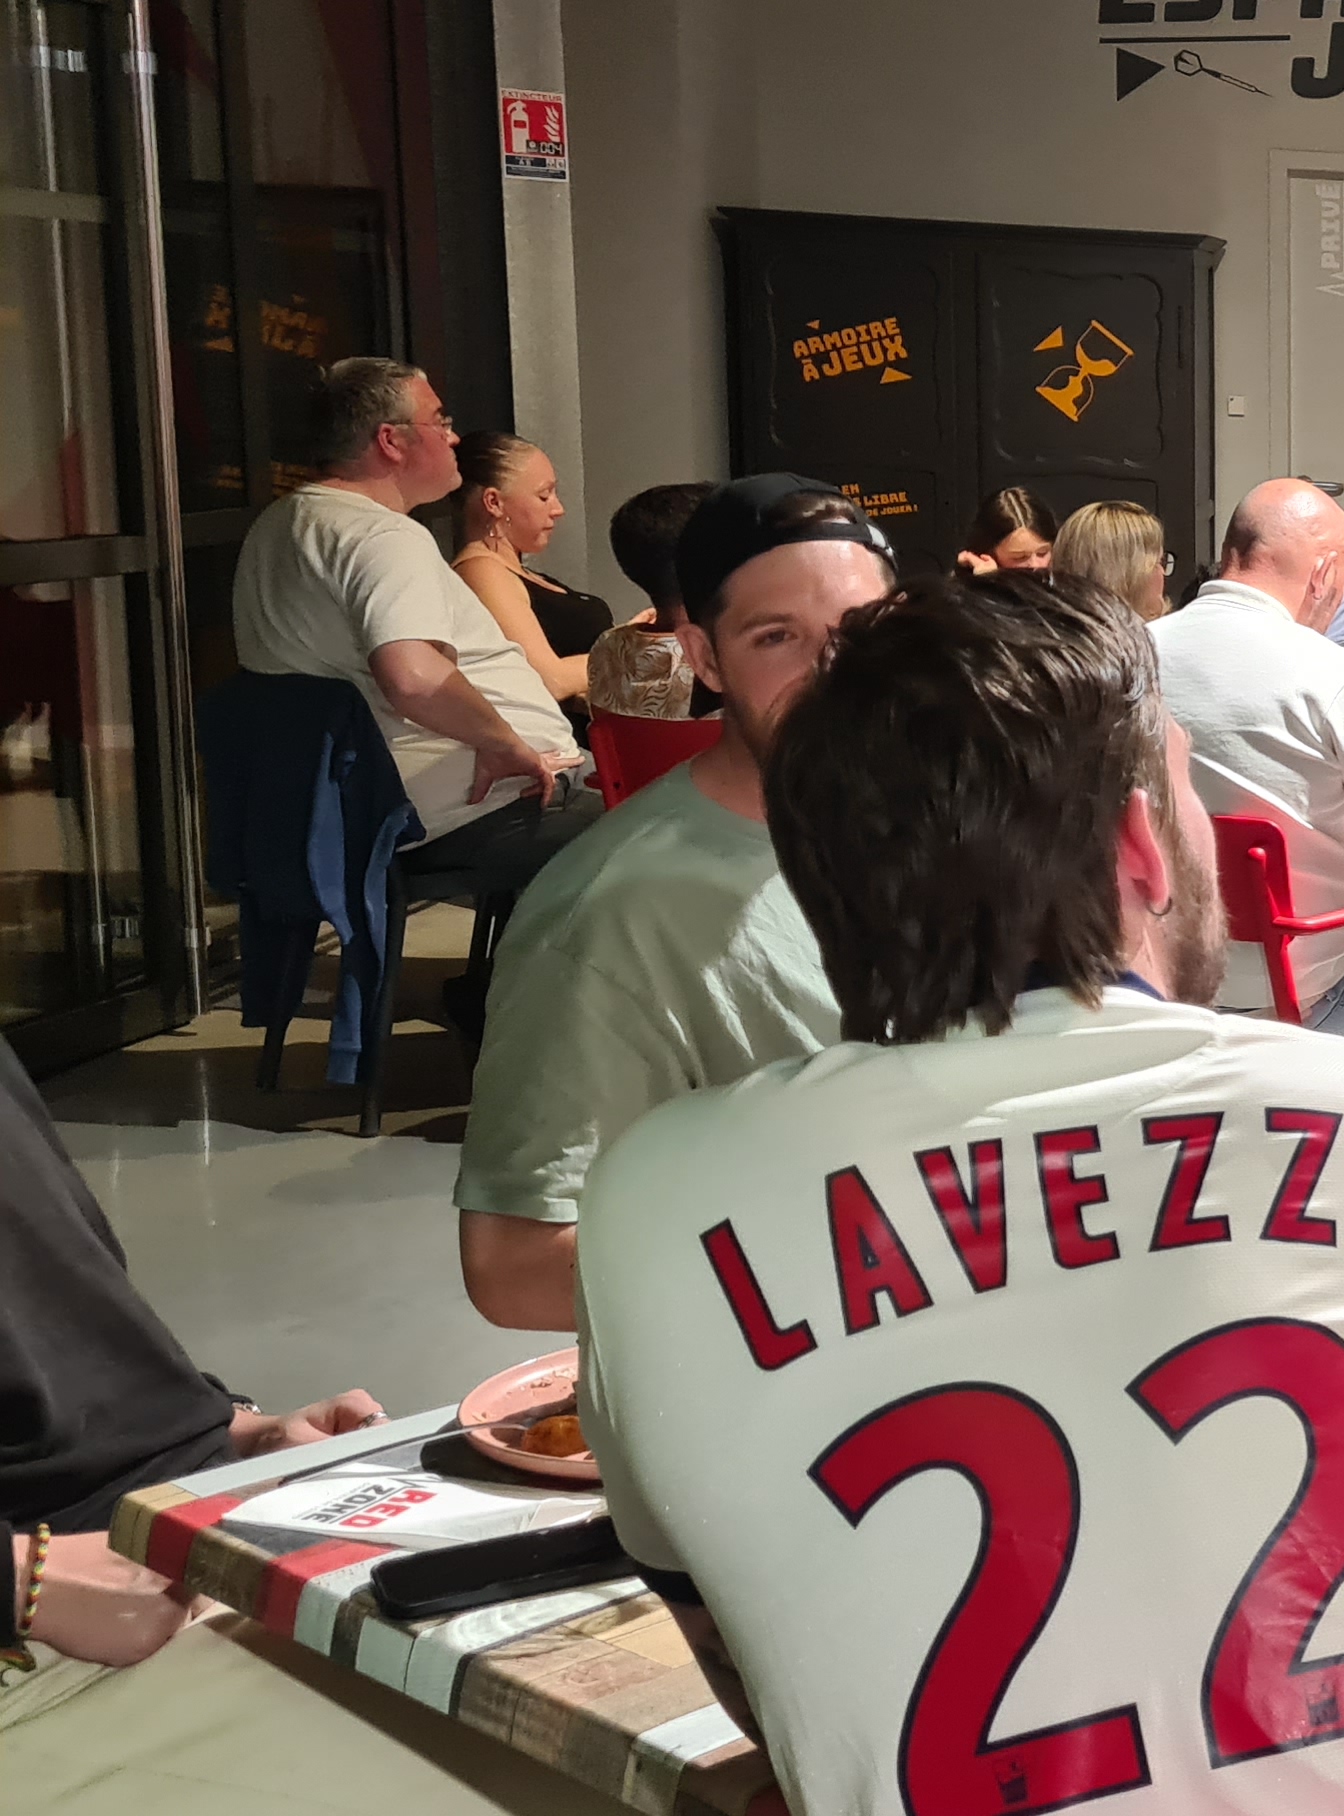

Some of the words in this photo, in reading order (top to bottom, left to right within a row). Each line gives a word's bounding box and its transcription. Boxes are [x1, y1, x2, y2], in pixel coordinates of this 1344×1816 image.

[501, 90, 562, 101] EXTINCTEUR
[540, 142, 562, 154] 004
[1315, 183, 1340, 269] PRIVÉ
[793, 317, 900, 358] ARMOIRE
[801, 359, 820, 382] À
[821, 335, 908, 377] JEUX
[863, 491, 908, 507] LIBRE
[300, 1484, 396, 1523] ZONE
[339, 1489, 438, 1528] RED
